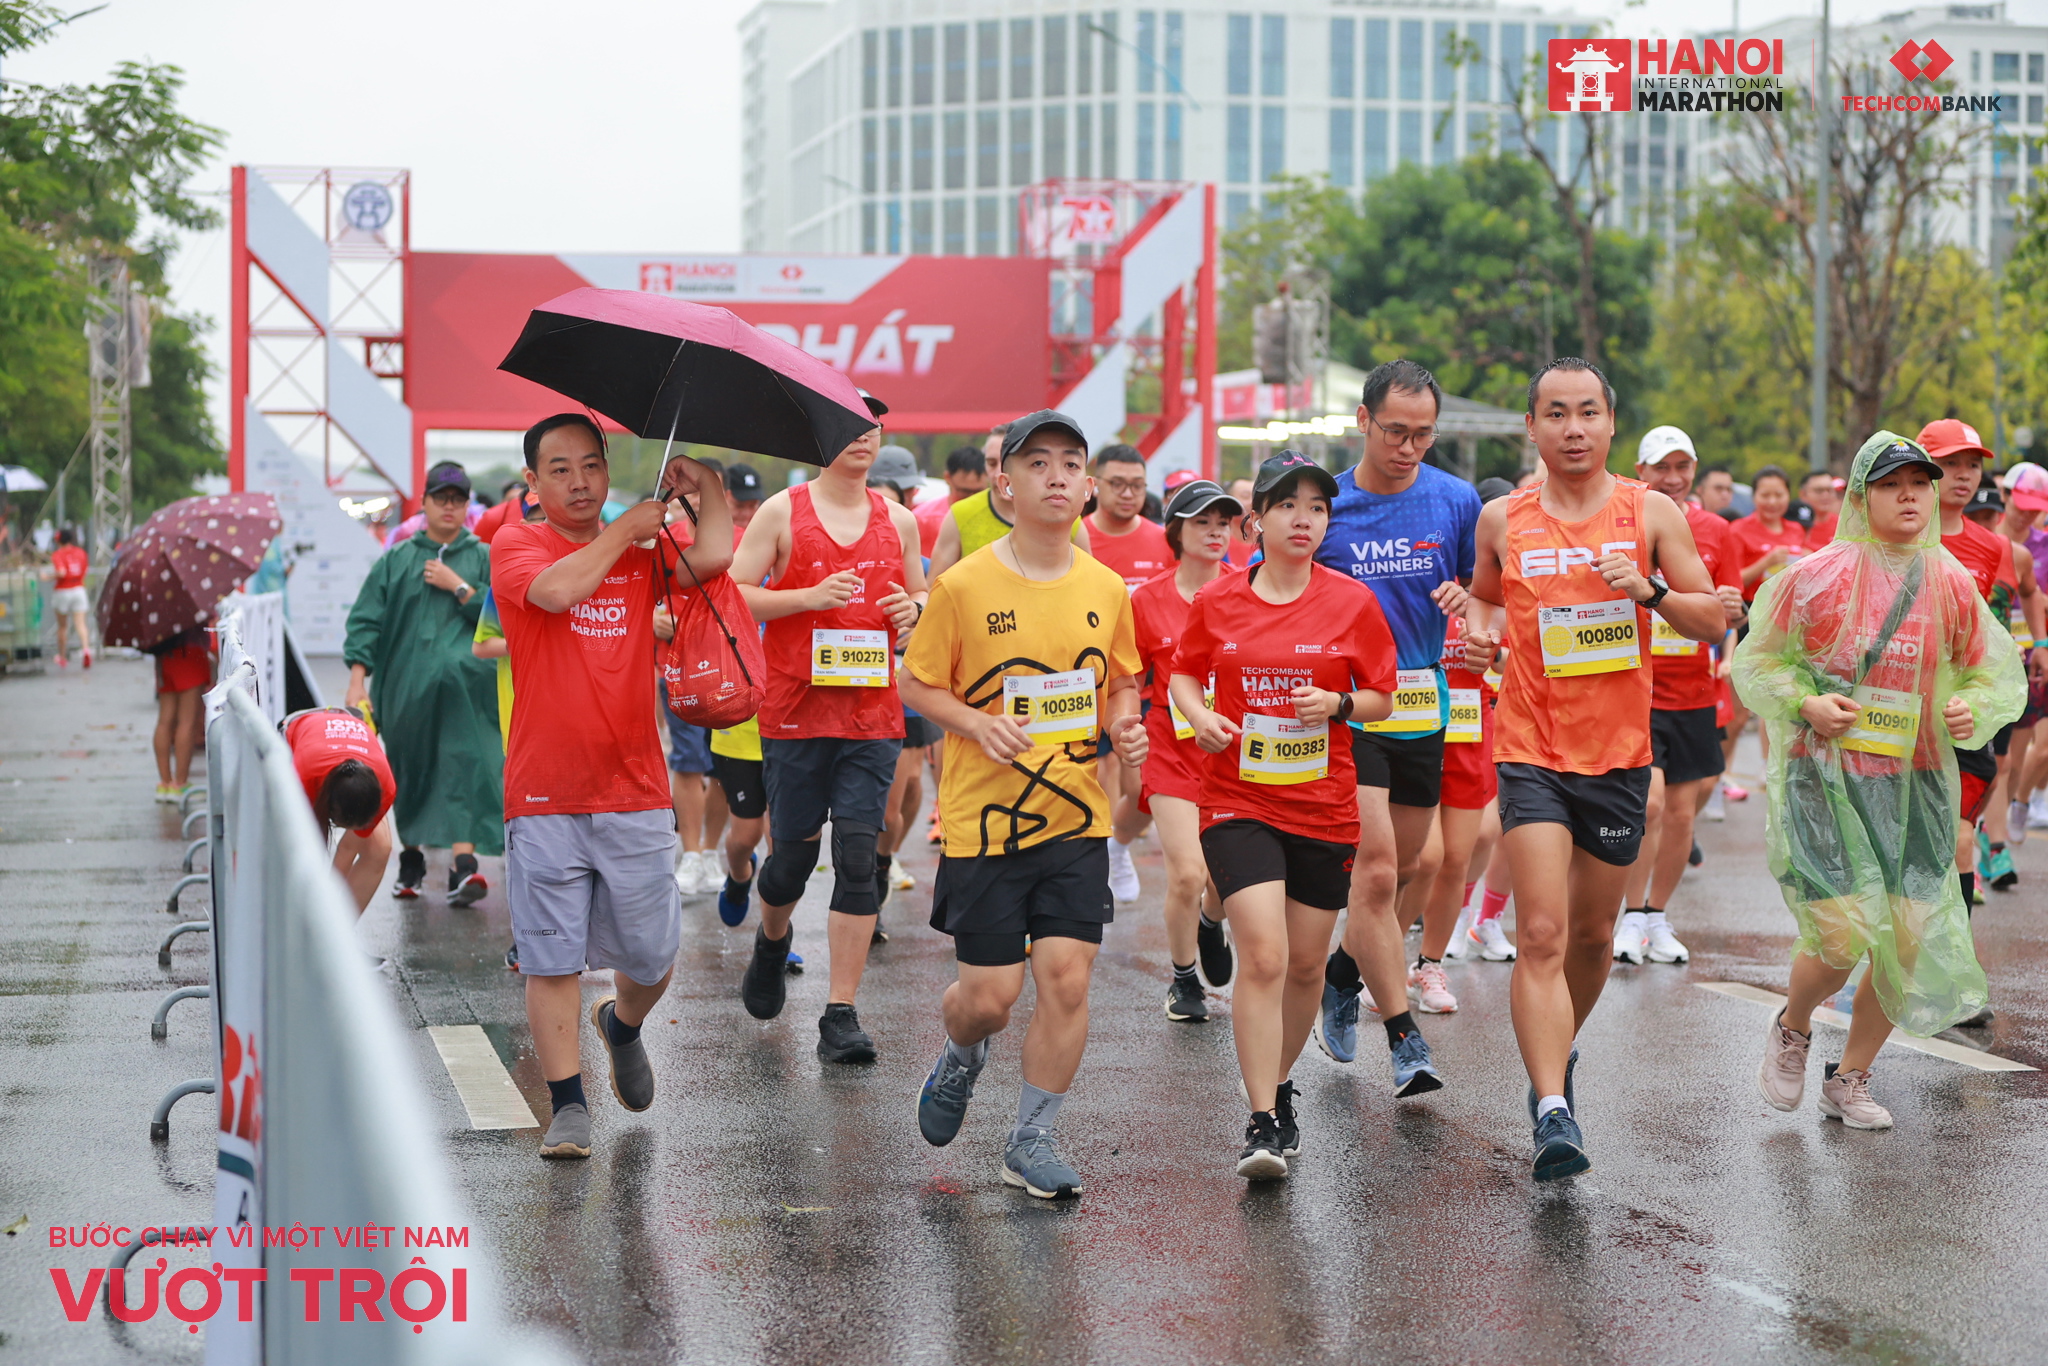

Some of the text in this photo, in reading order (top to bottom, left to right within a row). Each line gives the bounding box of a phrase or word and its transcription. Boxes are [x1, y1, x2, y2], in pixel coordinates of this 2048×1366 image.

[673, 264, 737, 278] HANOI
[1350, 537, 1412, 561] VMS
[1351, 556, 1434, 576] RUNNERS
[570, 603, 627, 622] HANOI
[986, 609, 1016, 626] OM
[570, 622, 627, 638] MARATHON
[988, 621, 1017, 636] RUN
[1576, 624, 1634, 645] 100800
[820, 649, 832, 665] E
[842, 651, 885, 663] 910273
[1241, 667, 1313, 676] TECHCOMBANK
[1241, 676, 1313, 692] HANOI
[1014, 697, 1029, 715] E
[1041, 694, 1093, 715] 100384
[1396, 692, 1436, 706] 100760
[1249, 739, 1264, 760] E
[1274, 738, 1325, 757] 100383
[1600, 826, 1632, 837] Basic
